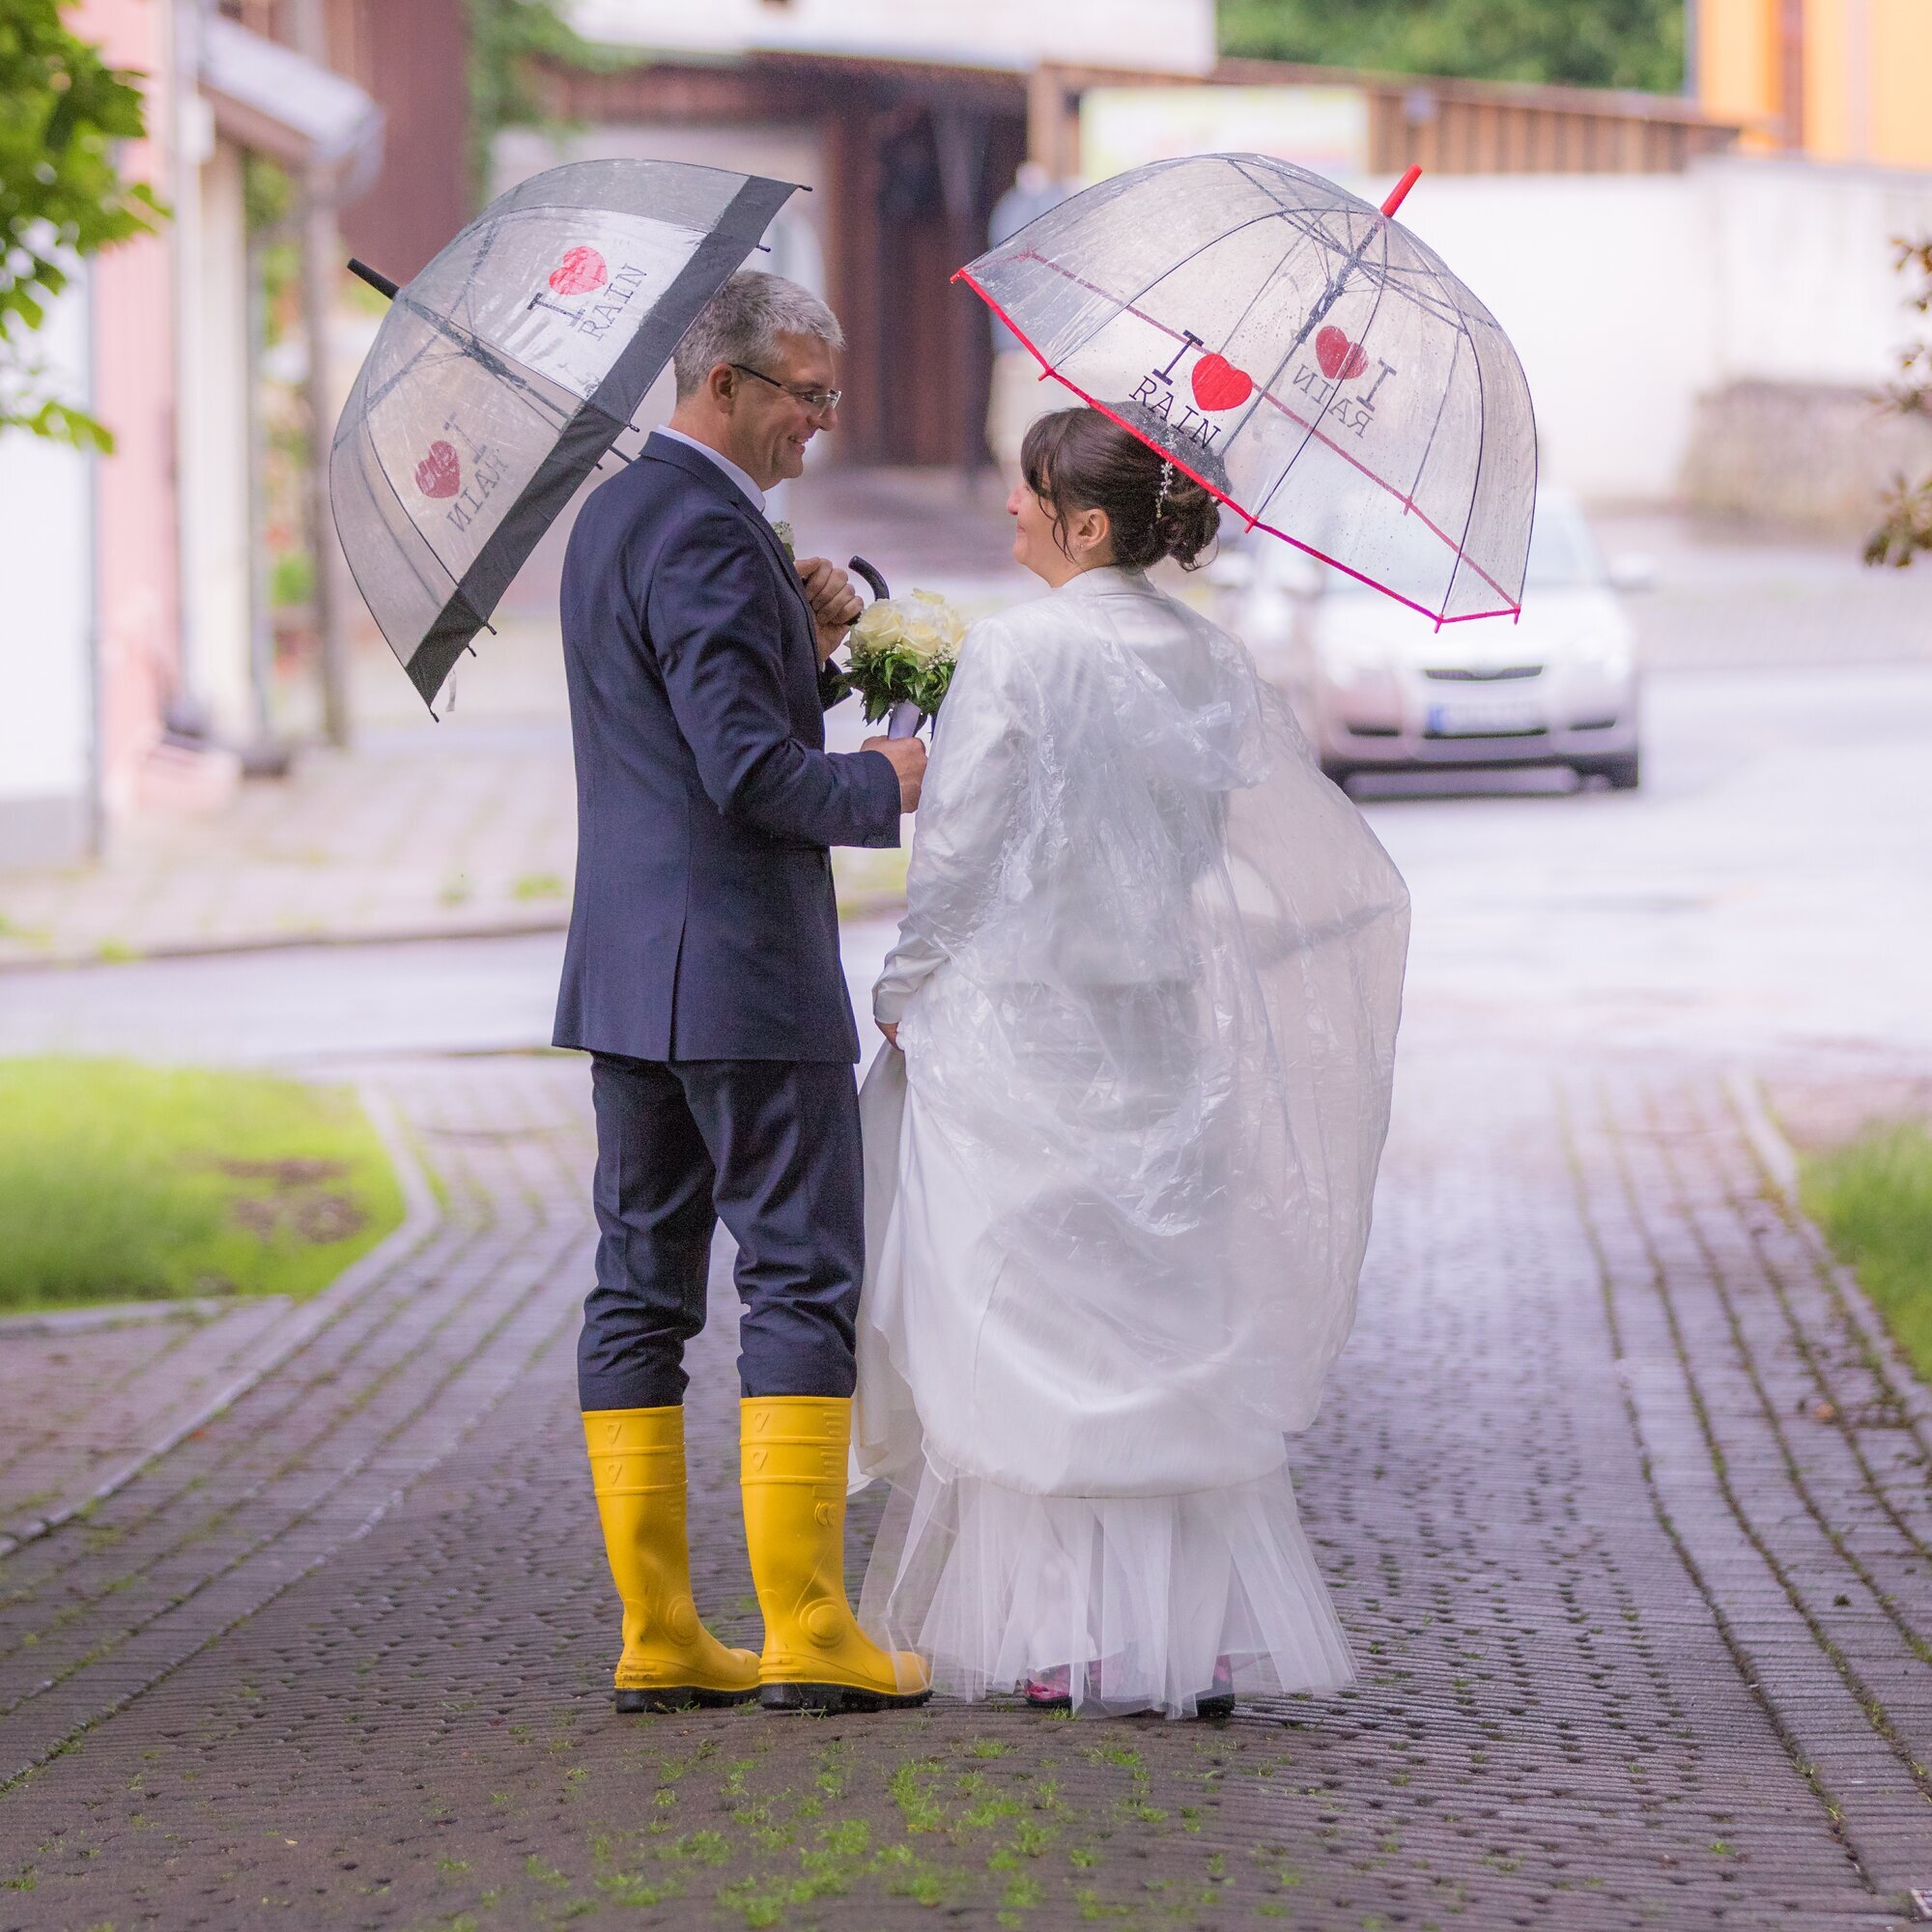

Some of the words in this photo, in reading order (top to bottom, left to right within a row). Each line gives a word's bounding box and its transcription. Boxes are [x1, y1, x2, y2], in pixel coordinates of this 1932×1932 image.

[526, 292, 585, 327] I
[578, 263, 647, 341] RAIN
[1151, 329, 1205, 386] I
[1128, 375, 1221, 449] RAIN
